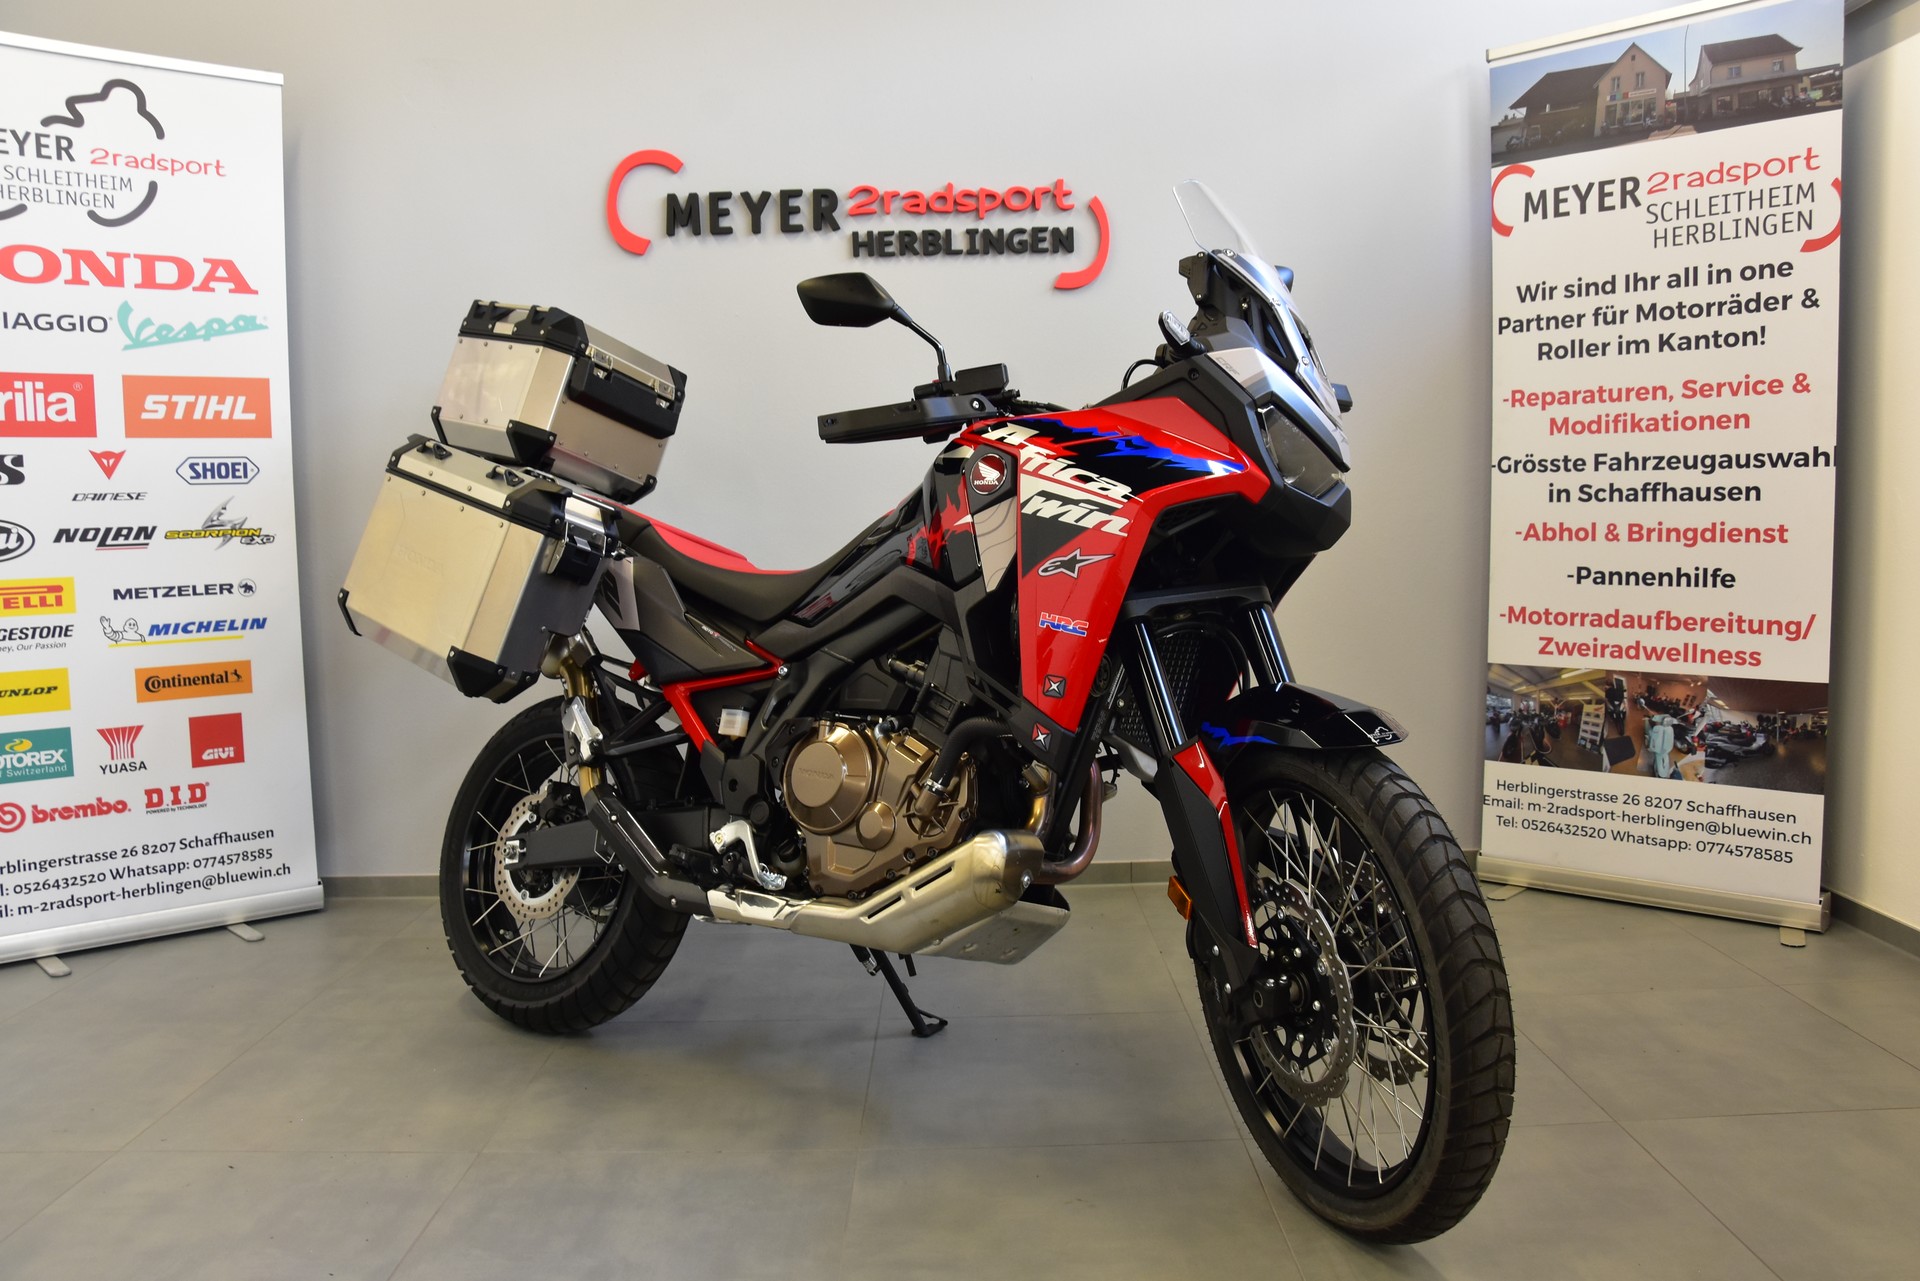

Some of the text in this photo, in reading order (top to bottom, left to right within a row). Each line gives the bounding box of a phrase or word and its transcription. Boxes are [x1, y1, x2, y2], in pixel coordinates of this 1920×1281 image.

[90, 147, 227, 177] 2radsport
[1646, 147, 1821, 196] 2radsport
[4, 165, 133, 192] SCHLEITHEIM
[666, 188, 841, 237] MEYER
[847, 178, 1076, 220] 2radsport
[1523, 176, 1642, 223] MEYER
[1646, 181, 1816, 225] SCHLEITHEIM
[852, 226, 1075, 258] HERBLINGEN
[1653, 209, 1814, 249] HERBLINGEN
[1516, 260, 1794, 304] Wir sind Ihr all in one
[2, 312, 109, 333] IAGGIO
[1498, 288, 1820, 335] Partner für Motorräder &
[117, 300, 269, 351] Vespa
[1537, 326, 1767, 361] Roller im Kanton!
[0, 380, 77, 422] rilia
[1503, 372, 1812, 411] -Reparaturen, Service &
[140, 394, 256, 420] STIHL
[1549, 409, 1751, 437] Modifikationen
[189, 462, 248, 480] SHOEI
[1491, 453, 1587, 474] -Grösste
[72, 491, 148, 502] DAINESE
[1548, 482, 1762, 503] in Schaffhausen
[53, 525, 157, 548] NOLAN
[165, 528, 262, 539] SCORPION
[240, 534, 275, 545] EXO
[1515, 521, 1789, 548] -Abhol & Bringdienst
[1567, 565, 1736, 589] -Pannenhilfe
[2, 595, 63, 609] ELLI
[113, 583, 234, 600] METZELER
[0, 624, 74, 642] GESTONE
[148, 617, 268, 637] MICHELIN
[1039, 611, 1089, 637] HRC
[1499, 605, 1817, 642] -Motorradaufbereitung/
[0, 640, 67, 654] ey, Our Passion
[1538, 636, 1762, 667] Zweiradwellness
[144, 670, 229, 693] Continental
[201, 746, 235, 760] GIVI
[6, 764, 67, 778] Switzerland
[99, 761, 147, 775] YUASA
[144, 782, 207, 809] D.I.D
[146, 807, 170, 815] POWERED
[176, 803, 208, 811] TECHNOLOGY
[1496, 779, 1797, 824] Herblingerstrasse 26 8207 Schaffhausen
[32, 797, 128, 824] brembo
[1482, 794, 1812, 845] Email: m-2radsport-herblingen@bluewin.ch
[0, 828, 275, 875] rblingerstrasse 26 8207 Schaffhausen
[1496, 815, 1793, 864] Tel: 0526432520 Whatsapp: 0774578585
[13, 872, 107, 895] 0526432520
[110, 860, 190, 881] Whatsapp:
[193, 848, 273, 869] 0774578585
[18, 863, 291, 915] m-2radsport-herblingen@bluewin.ch
